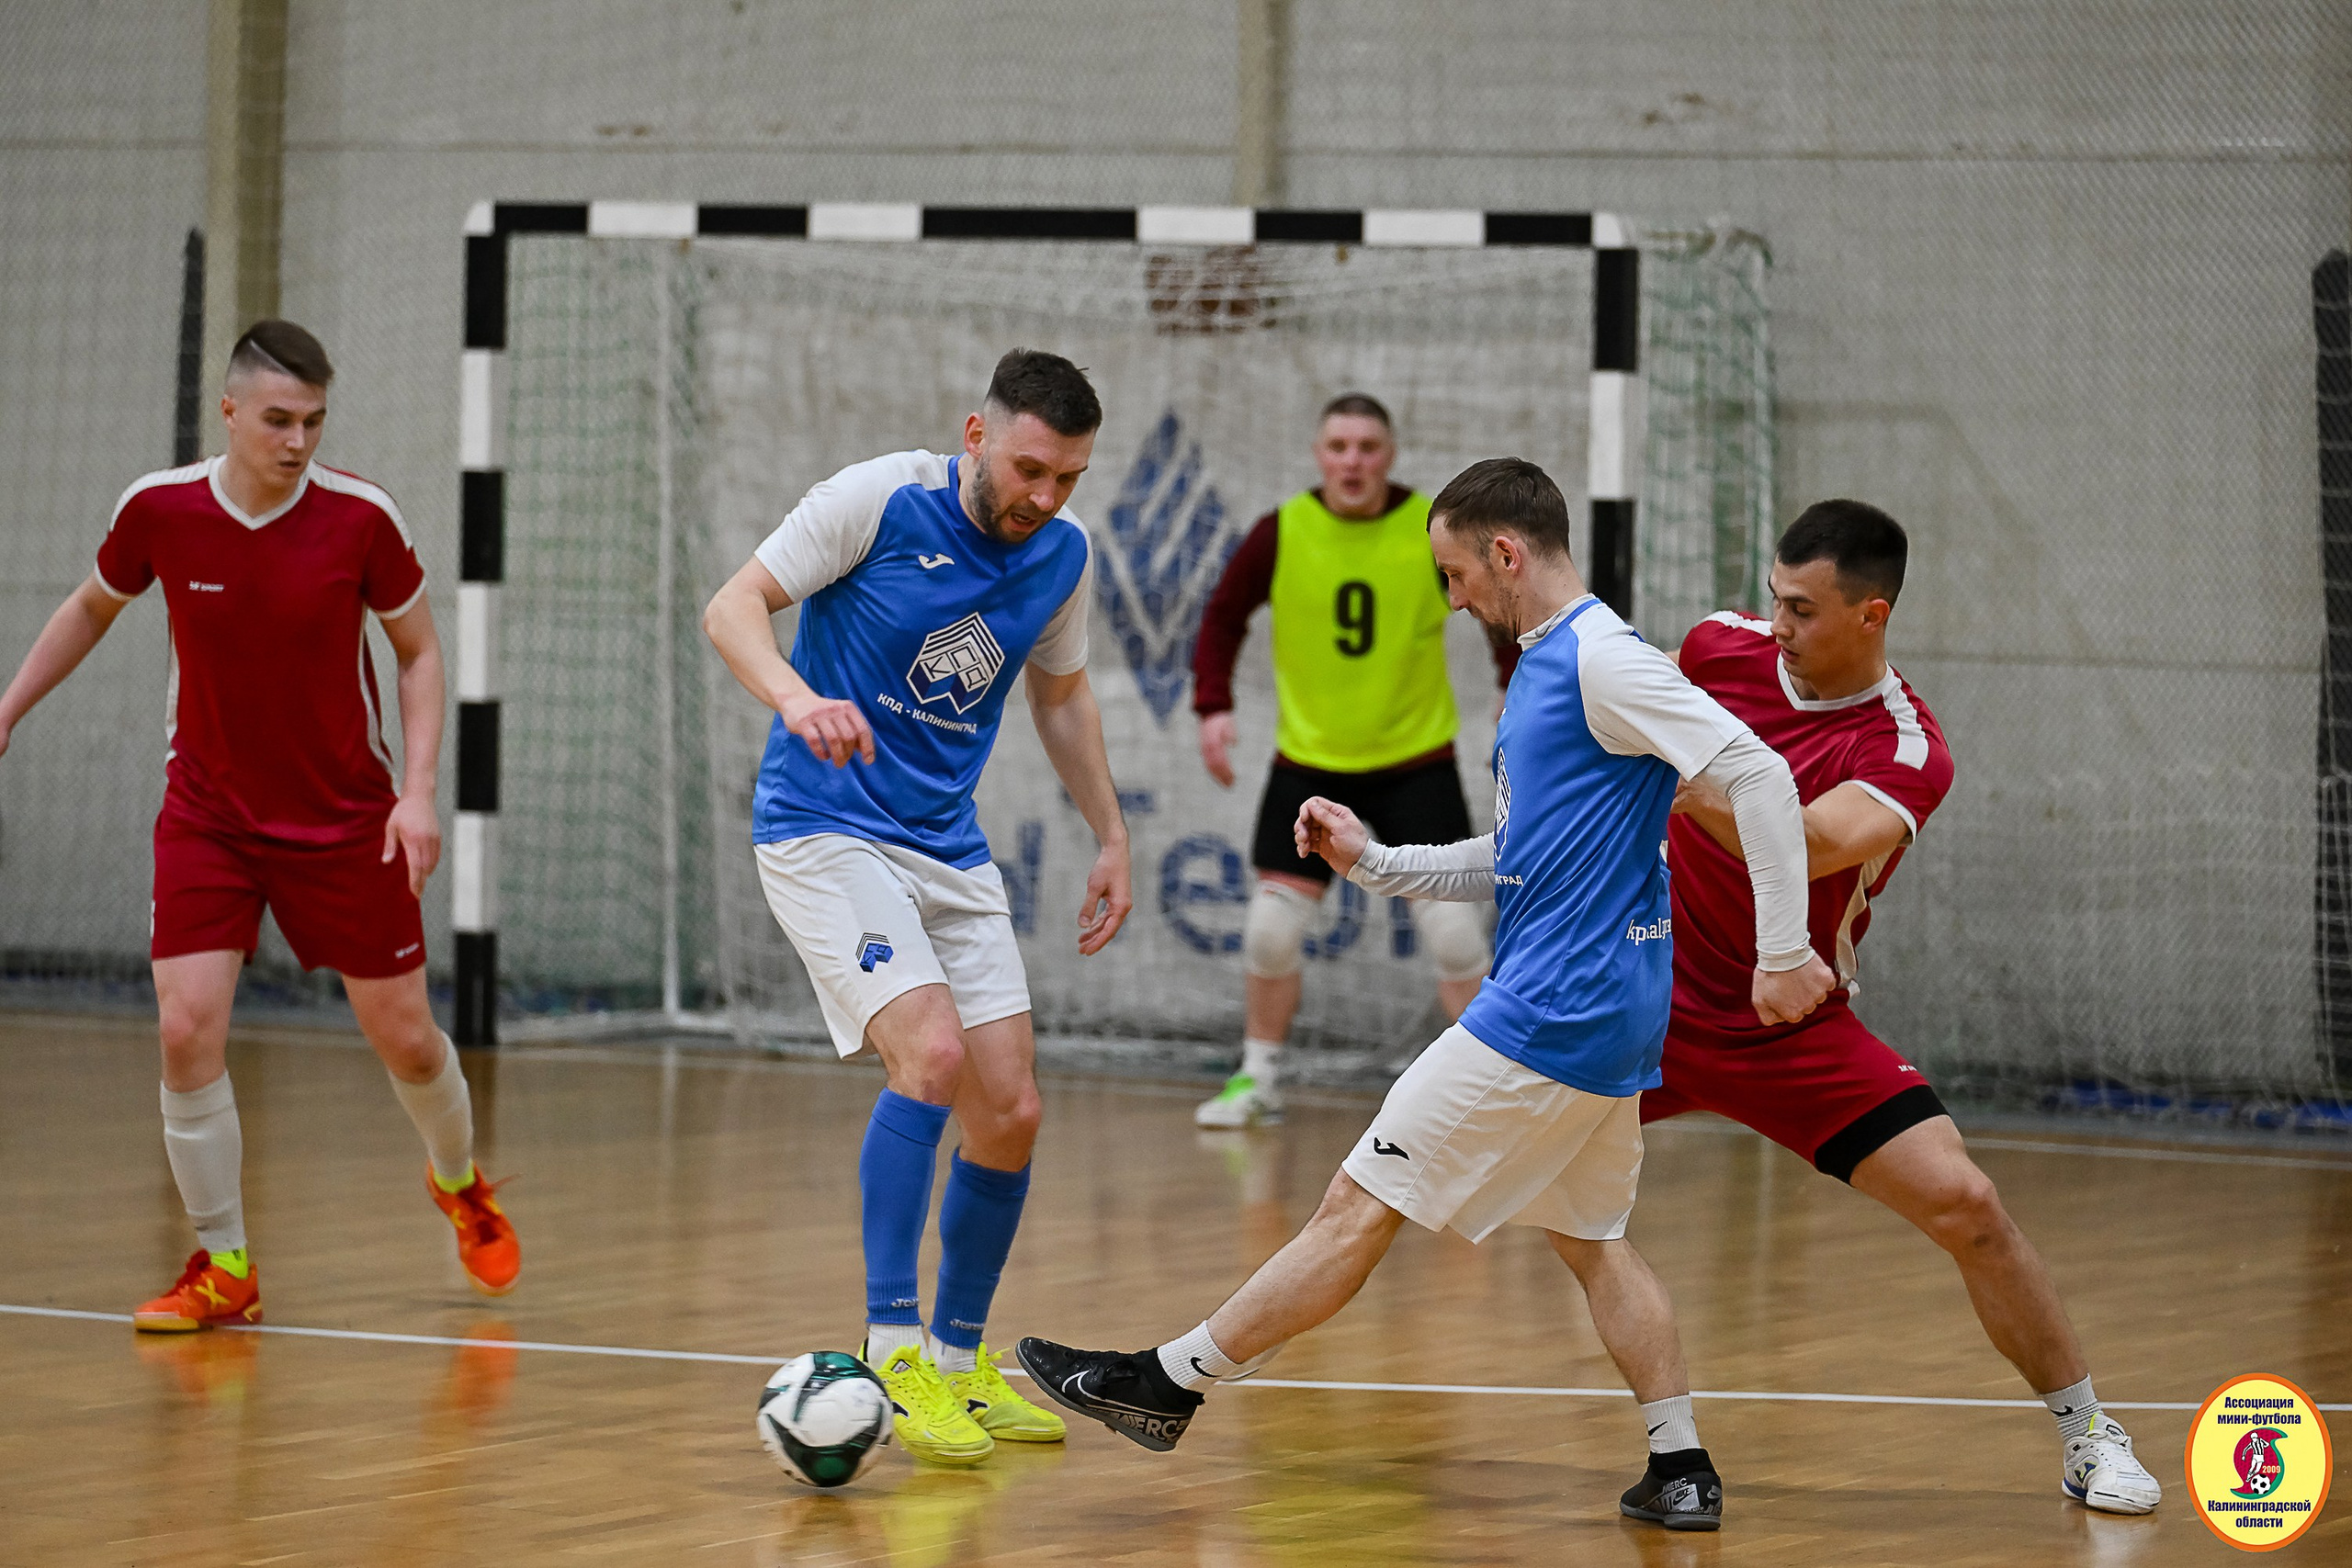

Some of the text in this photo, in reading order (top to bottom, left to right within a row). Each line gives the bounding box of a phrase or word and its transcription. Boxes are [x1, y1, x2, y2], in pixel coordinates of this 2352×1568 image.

[1336, 581, 1374, 658] 9
[876, 693, 904, 714] КПД
[911, 708, 977, 735] КАЛИНИНГРАД
